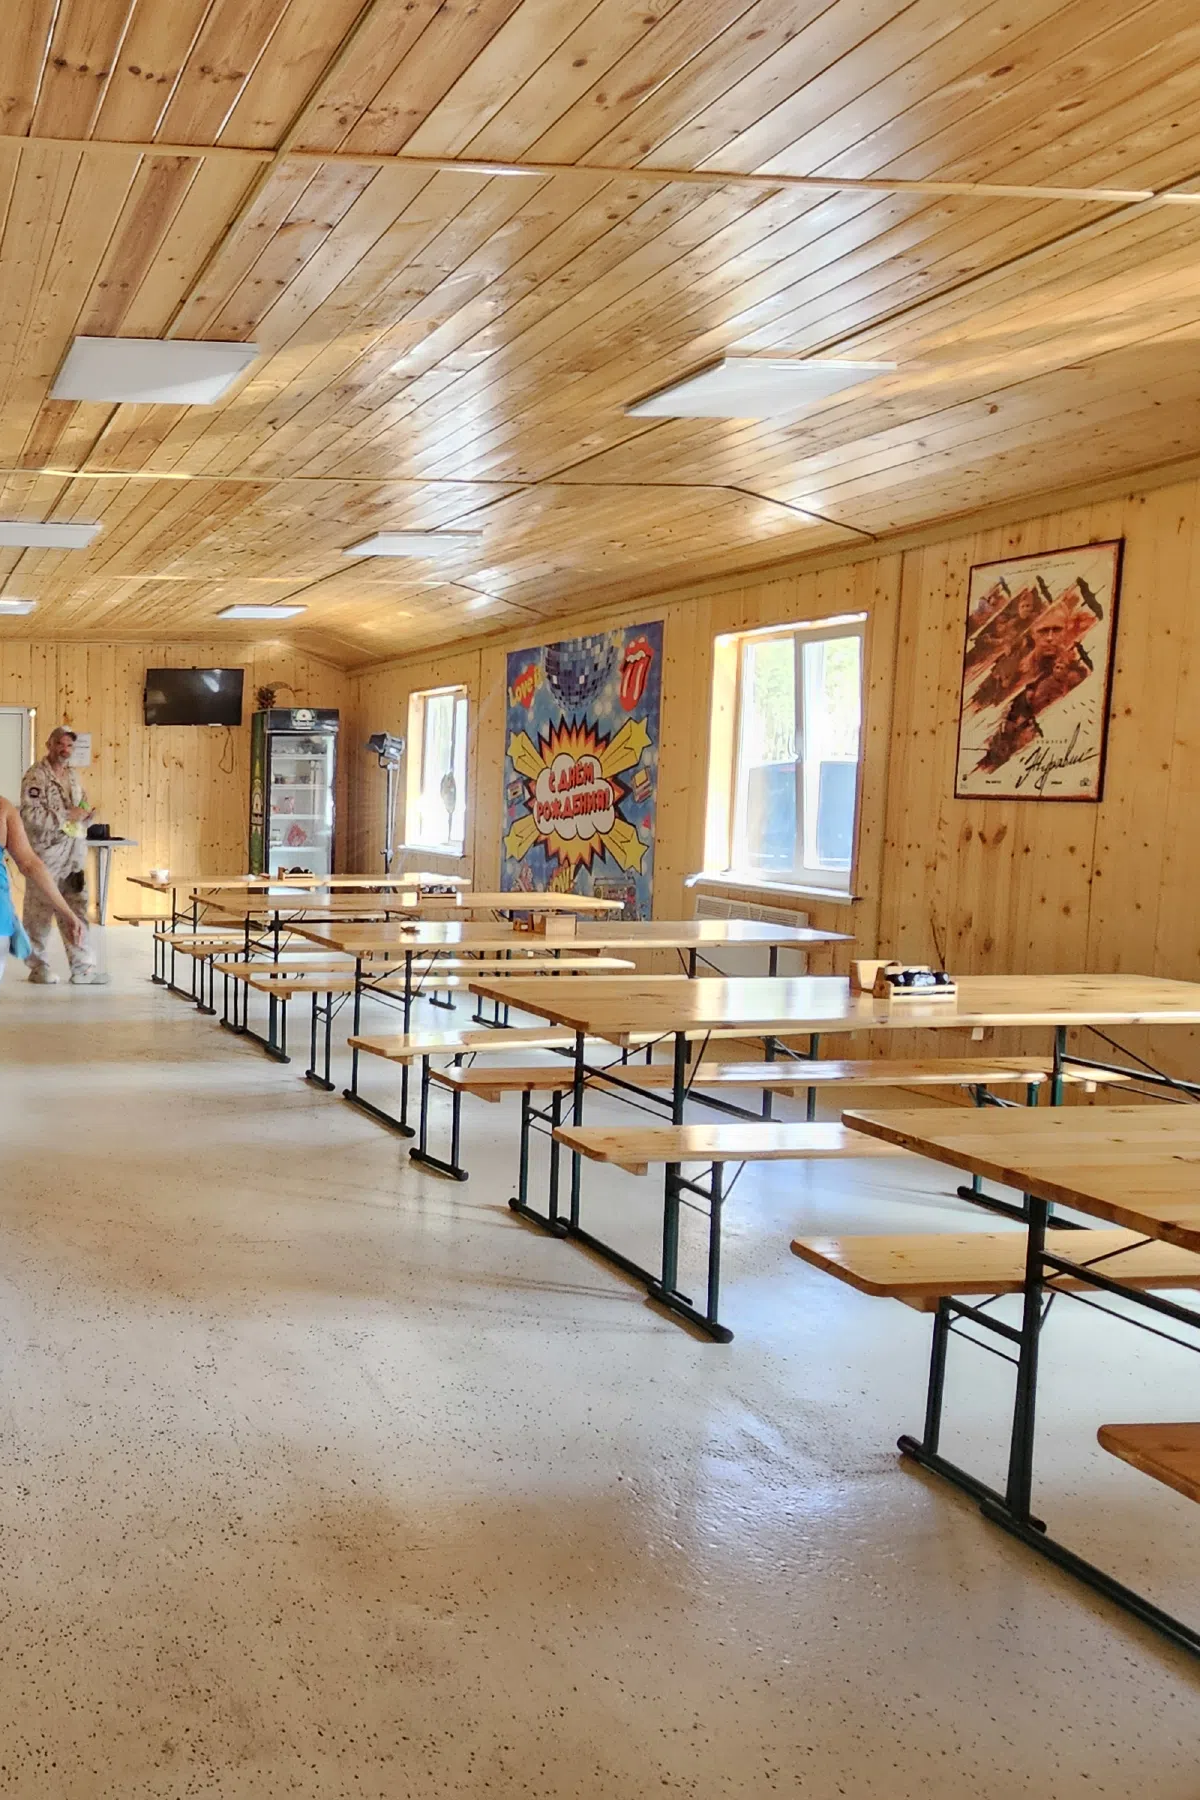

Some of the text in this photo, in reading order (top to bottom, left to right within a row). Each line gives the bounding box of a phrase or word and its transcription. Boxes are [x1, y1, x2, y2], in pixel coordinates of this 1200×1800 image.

[548, 762, 595, 793] С ДНЁМ
[537, 788, 611, 824] РОЖДЕНИЯ!
